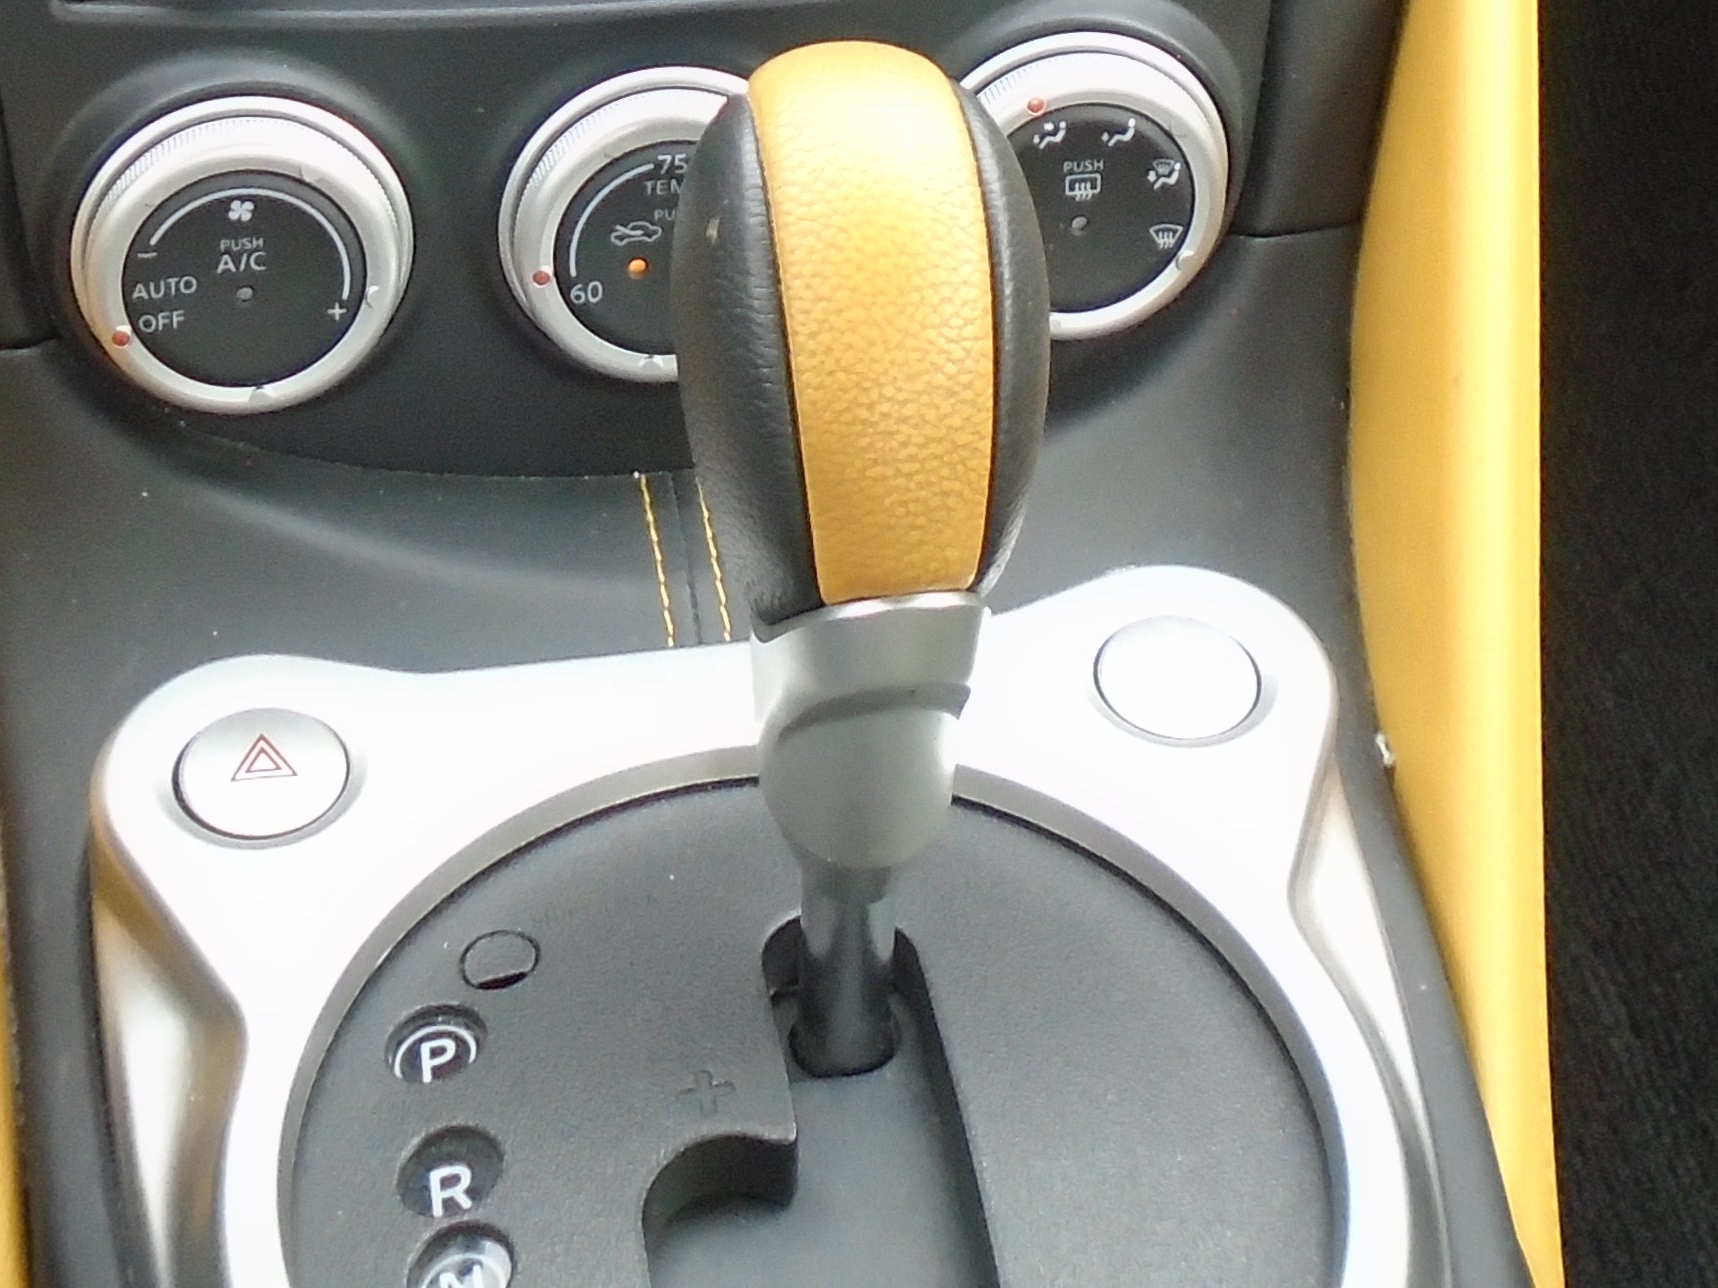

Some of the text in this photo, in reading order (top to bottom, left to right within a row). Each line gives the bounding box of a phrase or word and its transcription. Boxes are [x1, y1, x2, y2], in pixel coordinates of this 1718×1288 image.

[657, 153, 688, 174] 75
[1063, 159, 1104, 173] PUSH
[643, 178, 683, 196] TEM
[219, 236, 264, 253] PUSH
[216, 250, 267, 273] A/C
[132, 275, 197, 300] AUTO
[569, 280, 604, 305] 60
[138, 309, 186, 333] OFF
[419, 1036, 458, 1083] P
[427, 1164, 473, 1217] R
